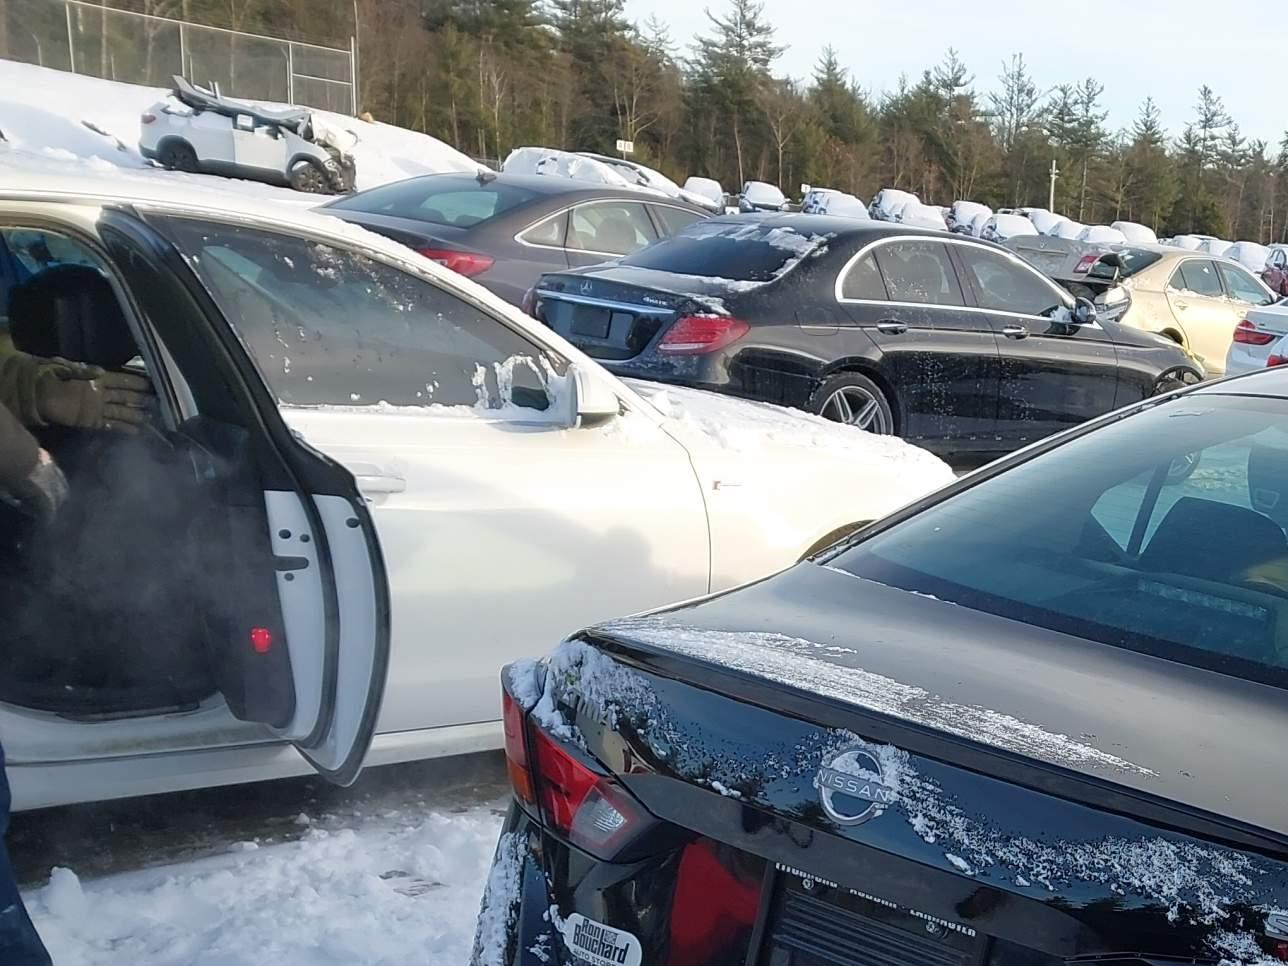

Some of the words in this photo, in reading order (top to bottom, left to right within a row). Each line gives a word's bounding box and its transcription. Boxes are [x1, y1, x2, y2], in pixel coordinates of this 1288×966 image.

[816, 769, 889, 801] NISSAN
[580, 918, 601, 939] Ron
[572, 923, 630, 964] Bouchard
[572, 945, 590, 960] AUTO
